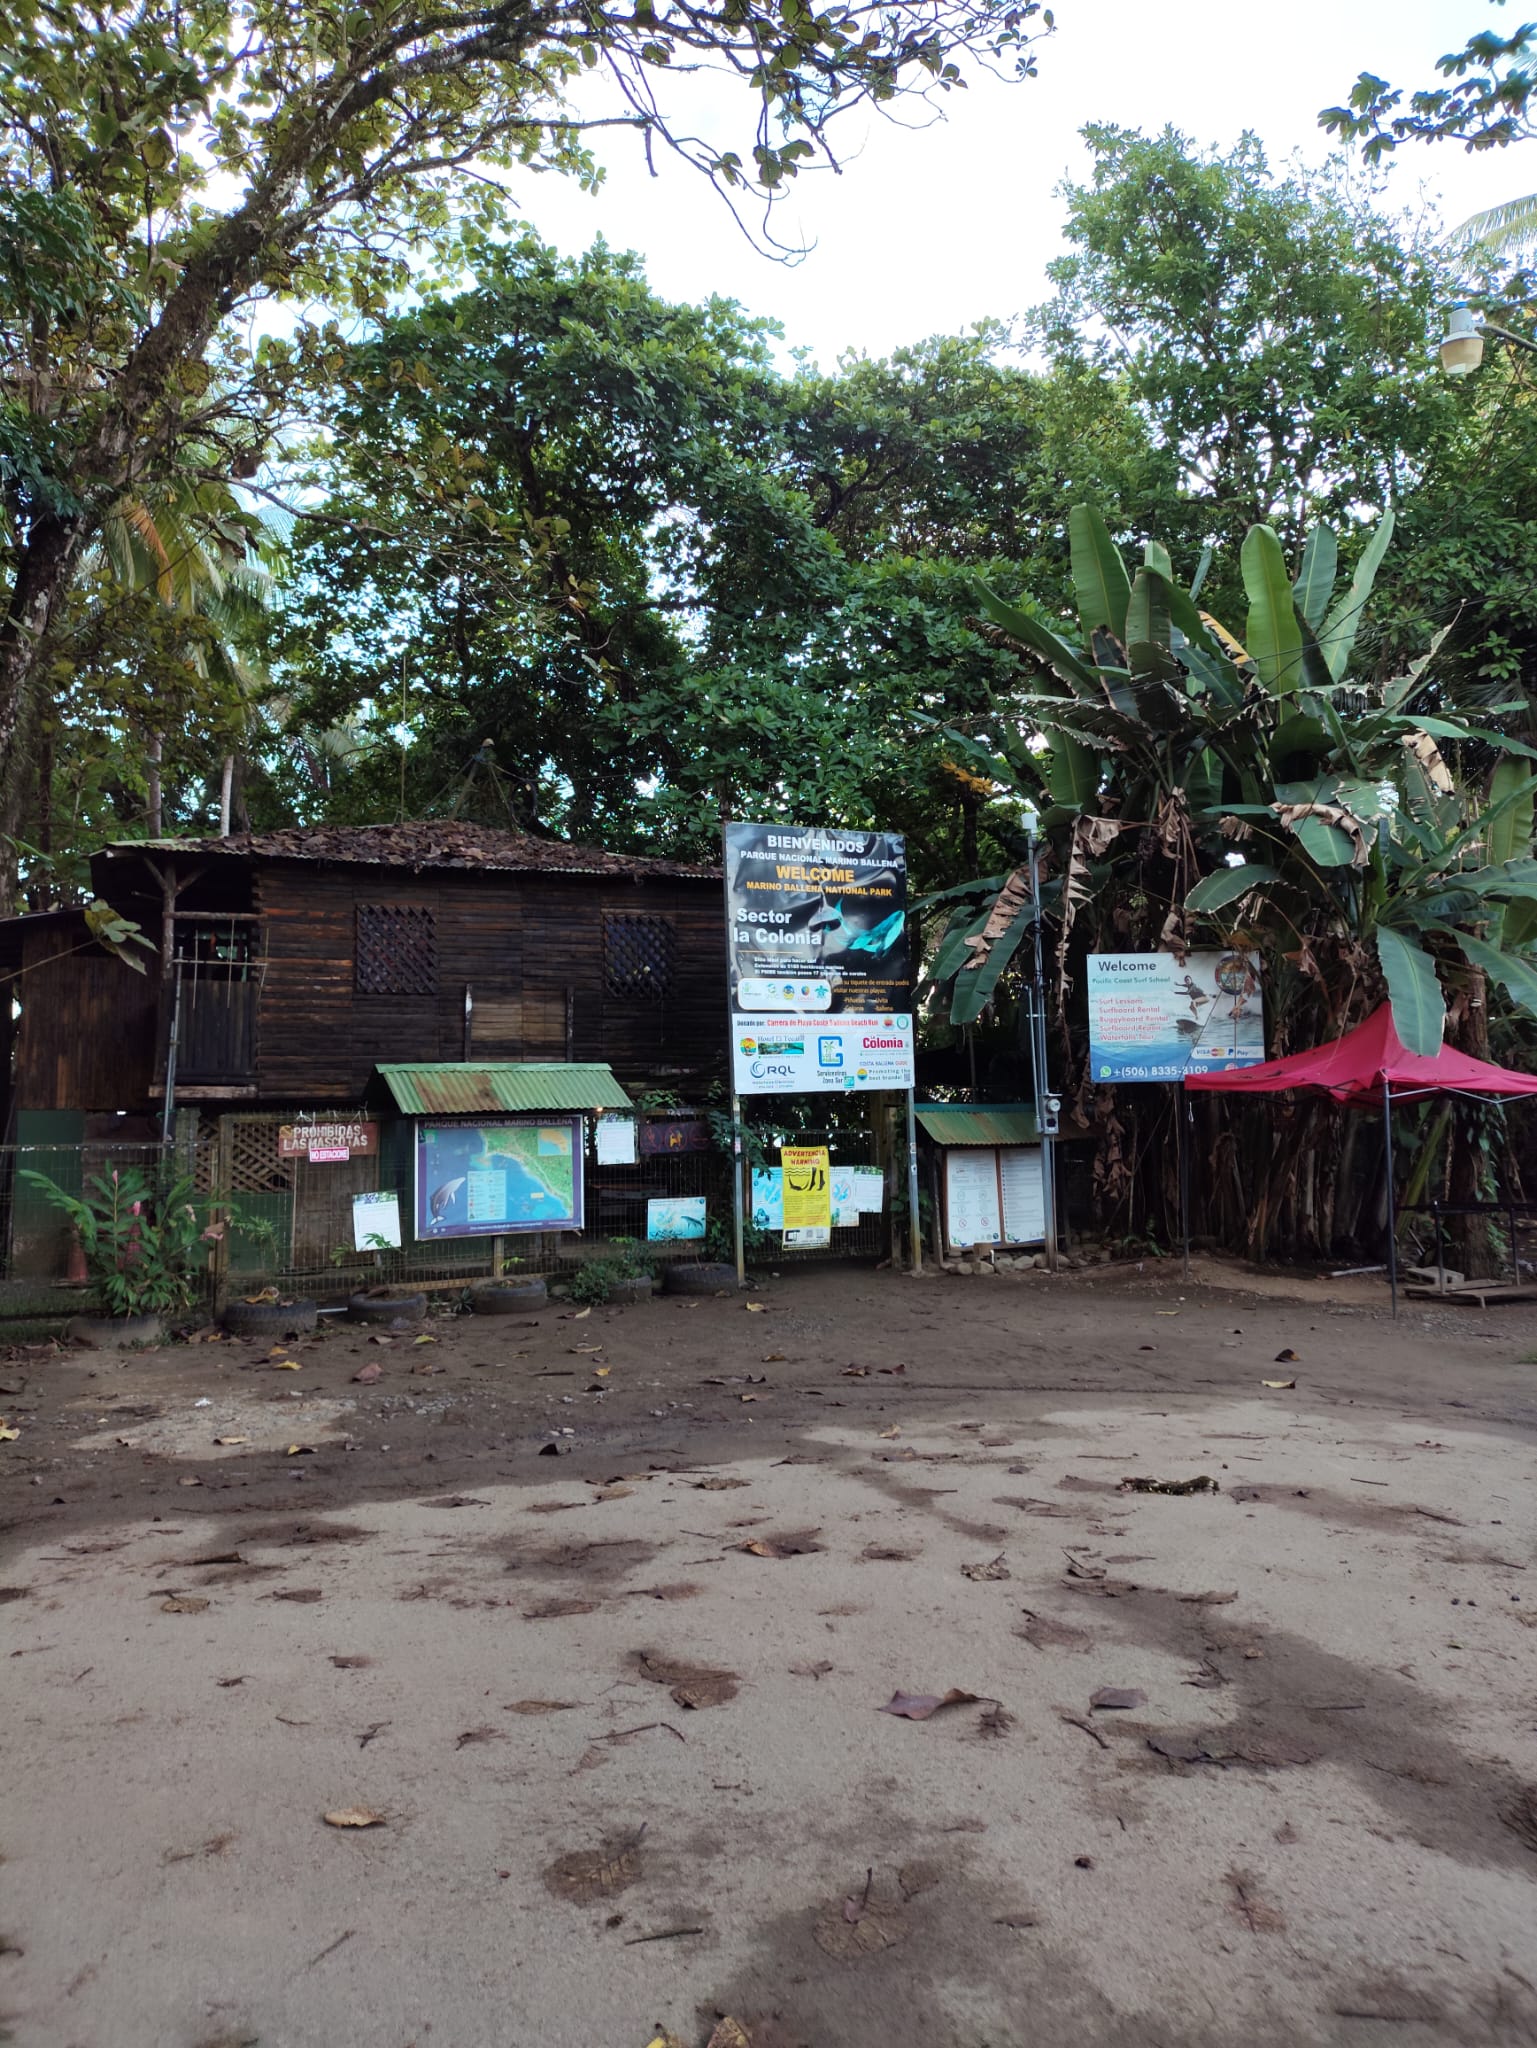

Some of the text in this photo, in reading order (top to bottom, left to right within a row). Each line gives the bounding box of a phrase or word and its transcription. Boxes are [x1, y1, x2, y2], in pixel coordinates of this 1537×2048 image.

[767, 834, 864, 854] BIENVENIDOS
[740, 850, 898, 868] PARQUE NACIONAL MARINO BALLENA
[776, 865, 855, 883] WELCOME
[746, 881, 892, 897] MARINO BALLENA NATIONAL PARK
[737, 907, 792, 924] Sector
[733, 927, 821, 945] la Colonia
[1098, 960, 1157, 972] Welcome
[798, 1019, 812, 1027] Playa
[1145, 1014, 1169, 1022] Rental
[863, 1037, 903, 1049] Colonia
[767, 1065, 796, 1077] RQL
[1113, 1066, 1148, 1078] +(506)
[424, 1118, 574, 1129] PARQUE NACIONAL MARINO BALLENA
[293, 1124, 361, 1139] PROHIBIDAS
[283, 1134, 368, 1151] LAS MASCOTAS
[783, 1149, 826, 1157] ADVERTENCIA
[790, 1158, 820, 1166] WARNING
